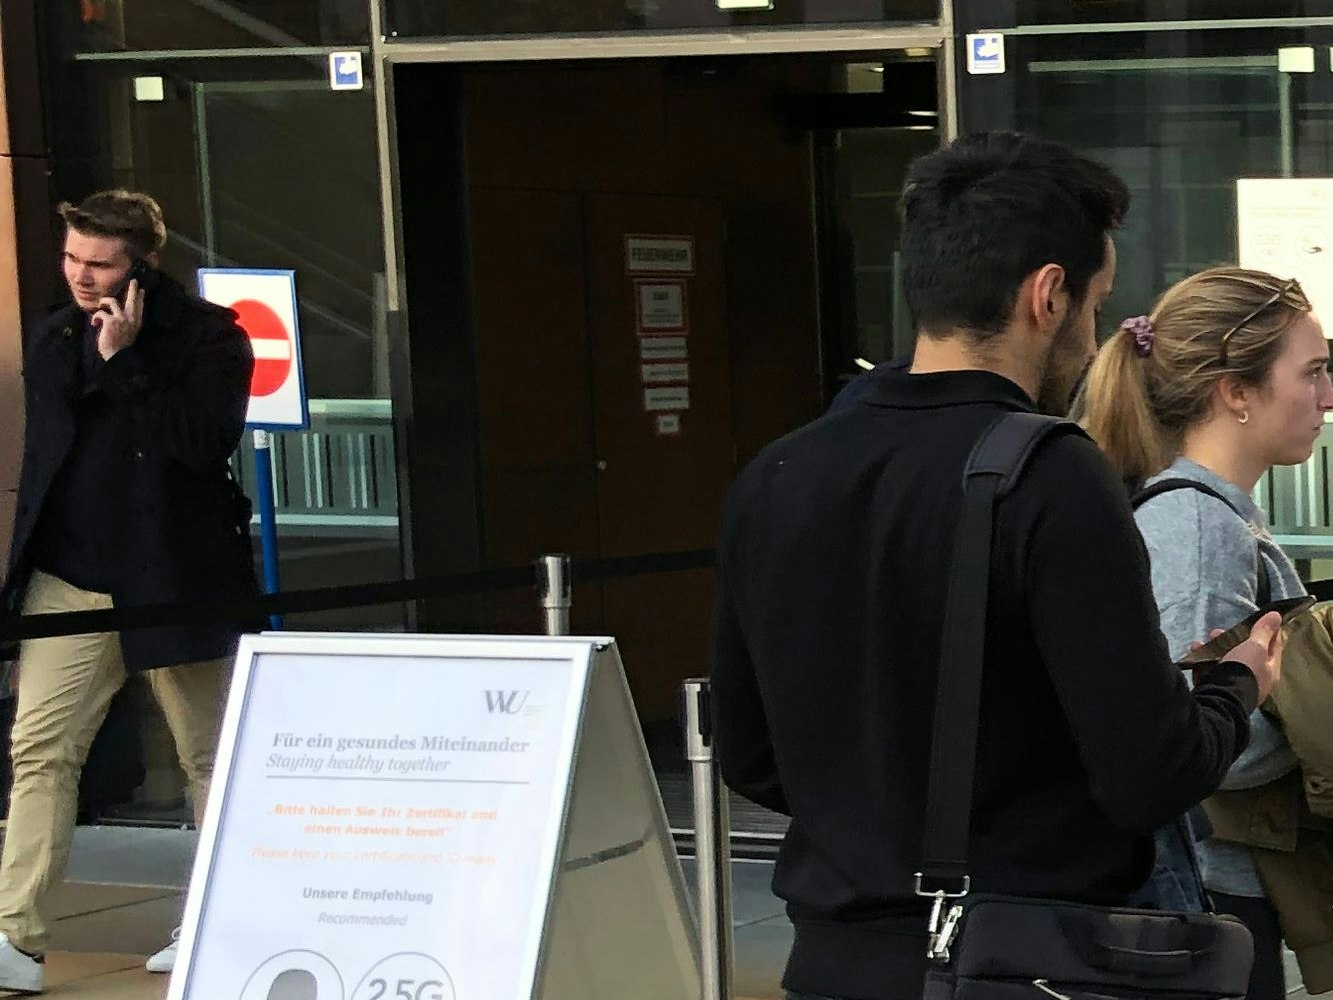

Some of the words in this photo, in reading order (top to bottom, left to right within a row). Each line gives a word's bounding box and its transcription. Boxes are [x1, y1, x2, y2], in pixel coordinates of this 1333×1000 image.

[484, 689, 531, 715] WU
[272, 732, 303, 749] Für
[306, 733, 334, 750] ein
[336, 734, 417, 752] gesundes
[420, 735, 531, 753] Miteinander
[265, 753, 324, 771] Staying
[328, 754, 384, 773] healthy
[387, 755, 452, 774] together
[310, 804, 352, 817] halten
[355, 805, 375, 818] Sie
[380, 806, 402, 818] Ihr
[405, 807, 467, 821] Zertifikat
[471, 808, 498, 821] und
[303, 823, 342, 836] einen
[345, 823, 402, 837] Ausweis
[302, 886, 349, 900] Unsere
[352, 888, 434, 905] Empfehlung
[317, 911, 409, 927] Recommended
